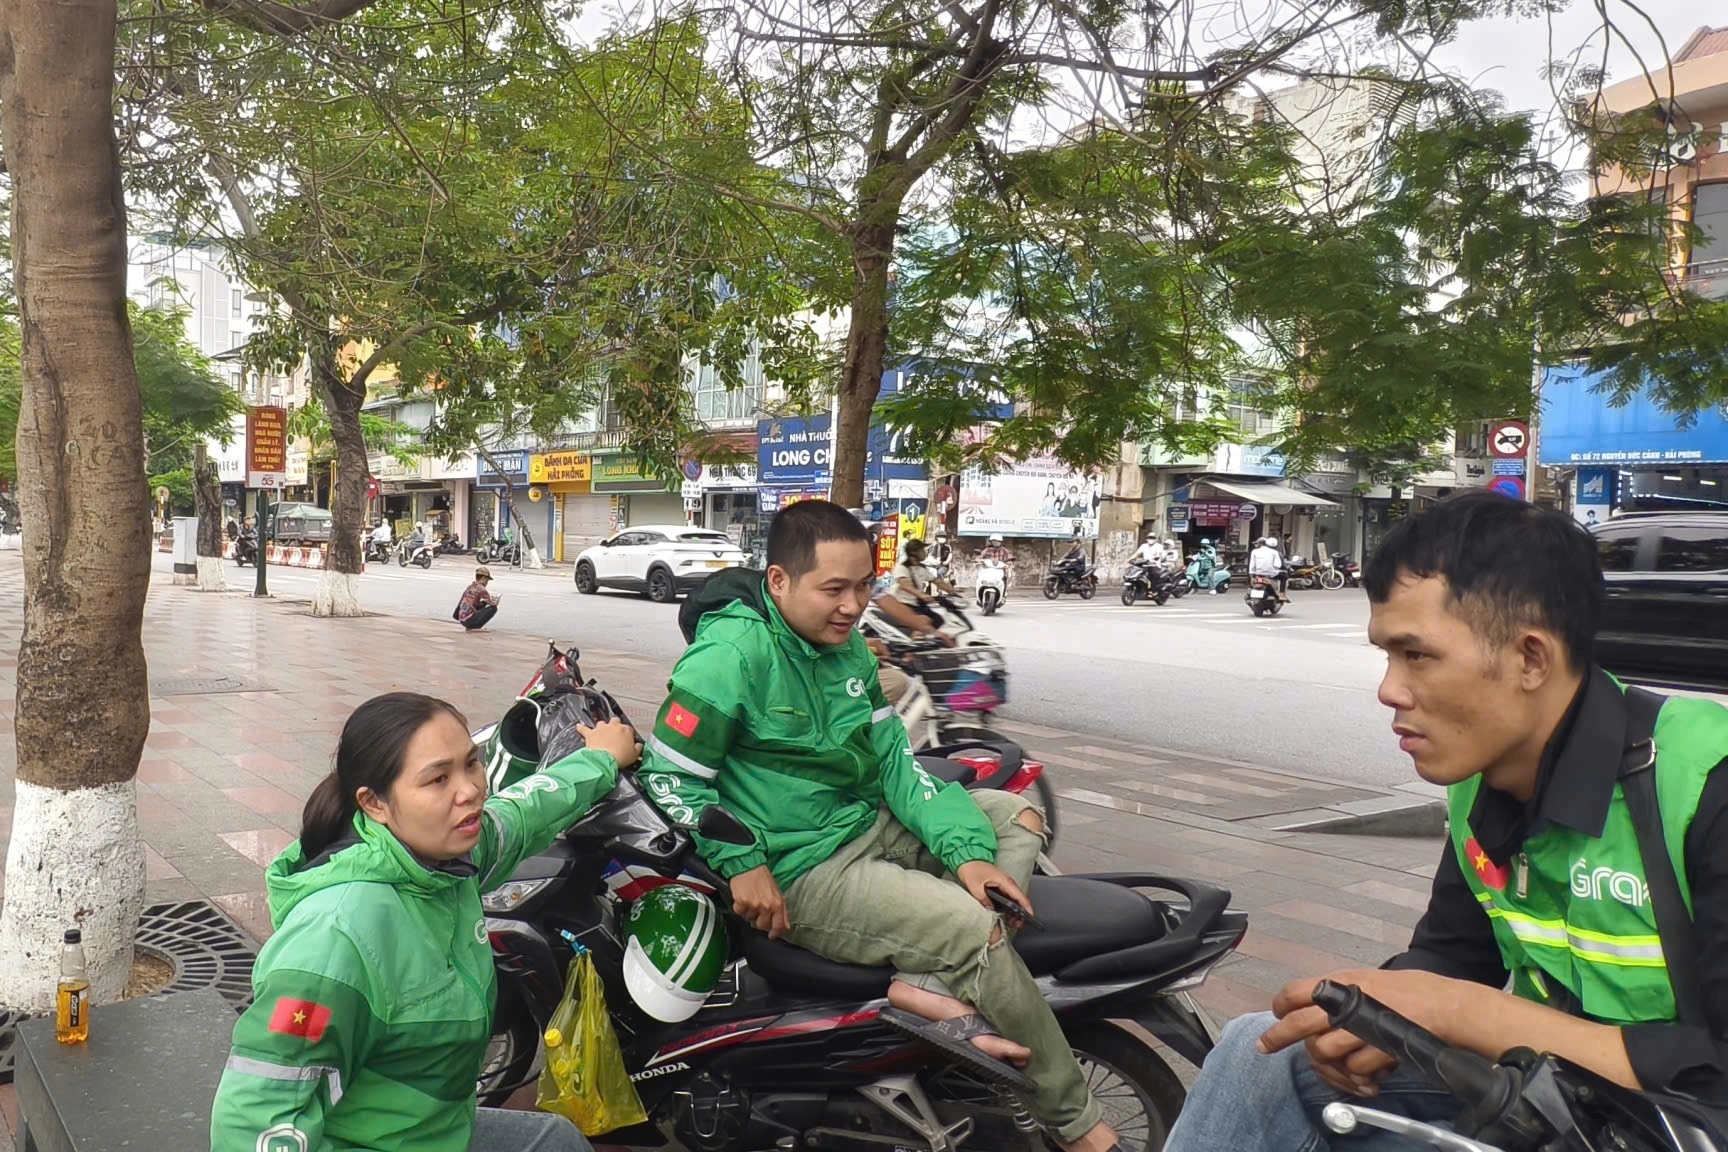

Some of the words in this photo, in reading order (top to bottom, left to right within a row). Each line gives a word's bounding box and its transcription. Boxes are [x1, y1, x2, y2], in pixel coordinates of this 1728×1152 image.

[789, 430, 808, 444] NHÀ
[808, 427, 833, 442] THUỐ
[544, 455, 561, 466] BÁNH
[563, 456, 572, 465] ĐA
[573, 455, 588, 464] CUA
[773, 450, 811, 466] LONG
[548, 468, 560, 480] HẢI
[561, 466, 584, 479] PHÒNG
[747, 466, 757, 477] 69
[262, 477, 274, 486] 5G
[880, 536, 897, 549] SỐT
[648, 773, 699, 826] Gra
[629, 1061, 691, 1083] HONDA
